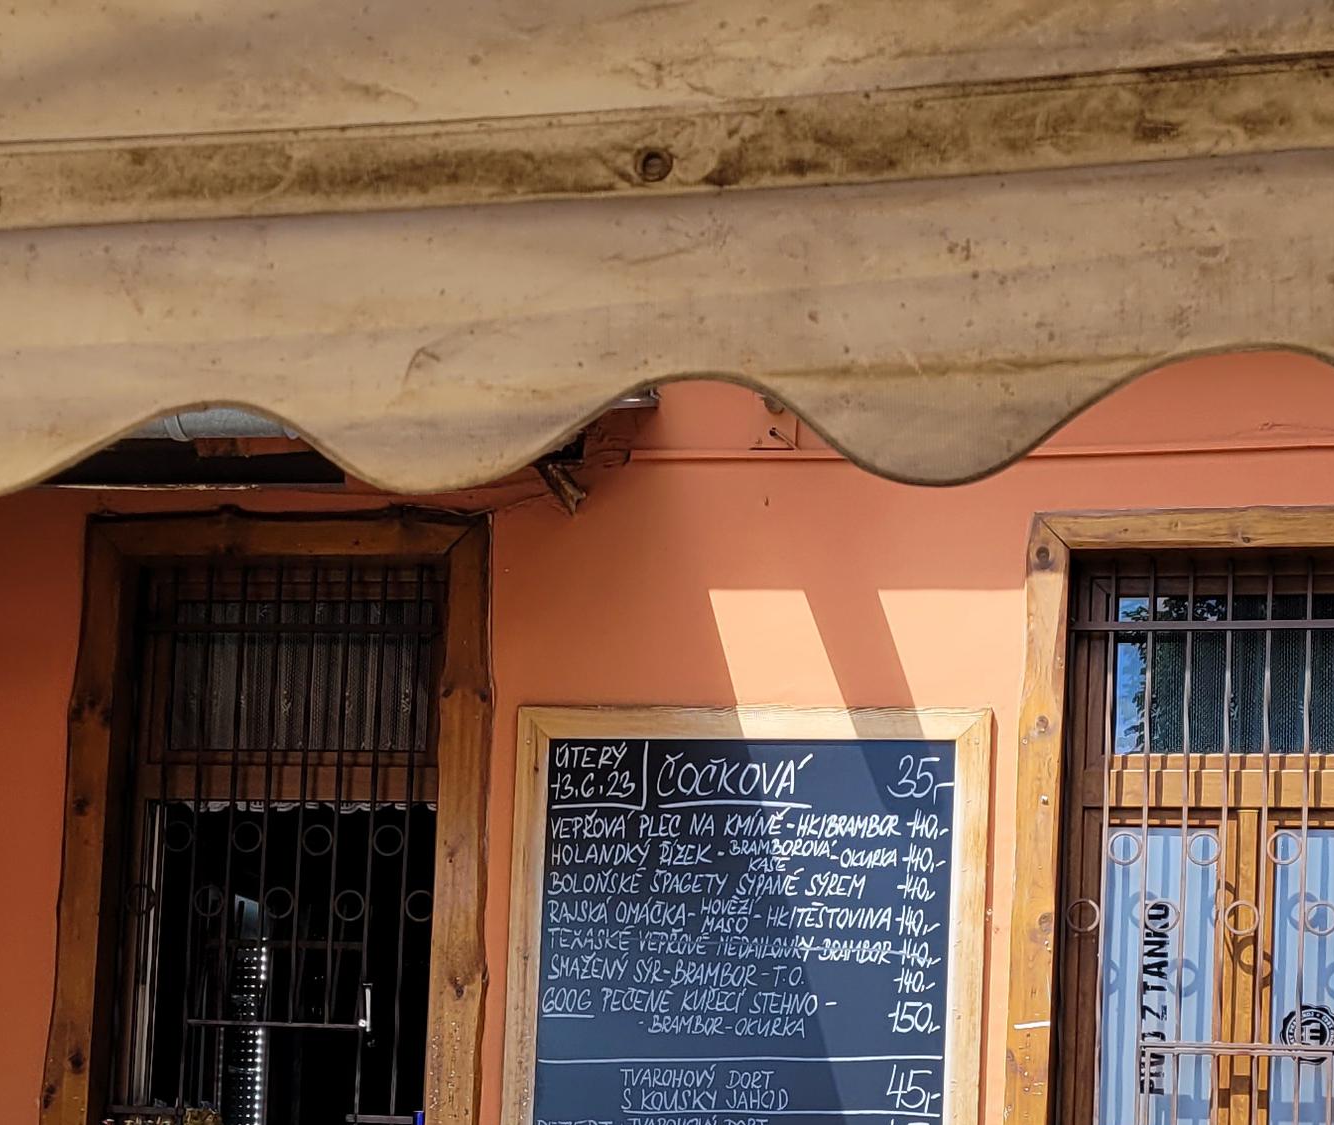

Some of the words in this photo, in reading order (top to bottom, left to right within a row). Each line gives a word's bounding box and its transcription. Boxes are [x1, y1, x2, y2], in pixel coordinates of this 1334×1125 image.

[555, 741, 628, 769] ÚTERÝ
[656, 751, 814, 798] ČOČKOVÁ
[551, 809, 636, 839] VEPŘOVÁ
[639, 813, 681, 839] PLEC
[689, 812, 715, 838] NA
[551, 838, 651, 867] HOLANDKÝ
[650, 868, 729, 896] ŠPAGETY
[736, 867, 805, 897] SYPANÉ
[805, 871, 867, 900] SÝREM
[548, 895, 614, 925] RAJSKÁ
[701, 914, 749, 933] MASO
[548, 952, 630, 982] SMAŽENÝ
[542, 986, 593, 1014] 600G
[601, 984, 675, 1015] PEČENÉ
[681, 985, 747, 1014] KUŘECÍ
[749, 991, 817, 1017] STEHNO
[620, 1064, 717, 1089] TVAROHOVÝ
[726, 1069, 774, 1090] DORT
[621, 1087, 633, 1111] S
[641, 1088, 718, 1112] KOUSKY
[726, 1088, 789, 1111] JAHOD
